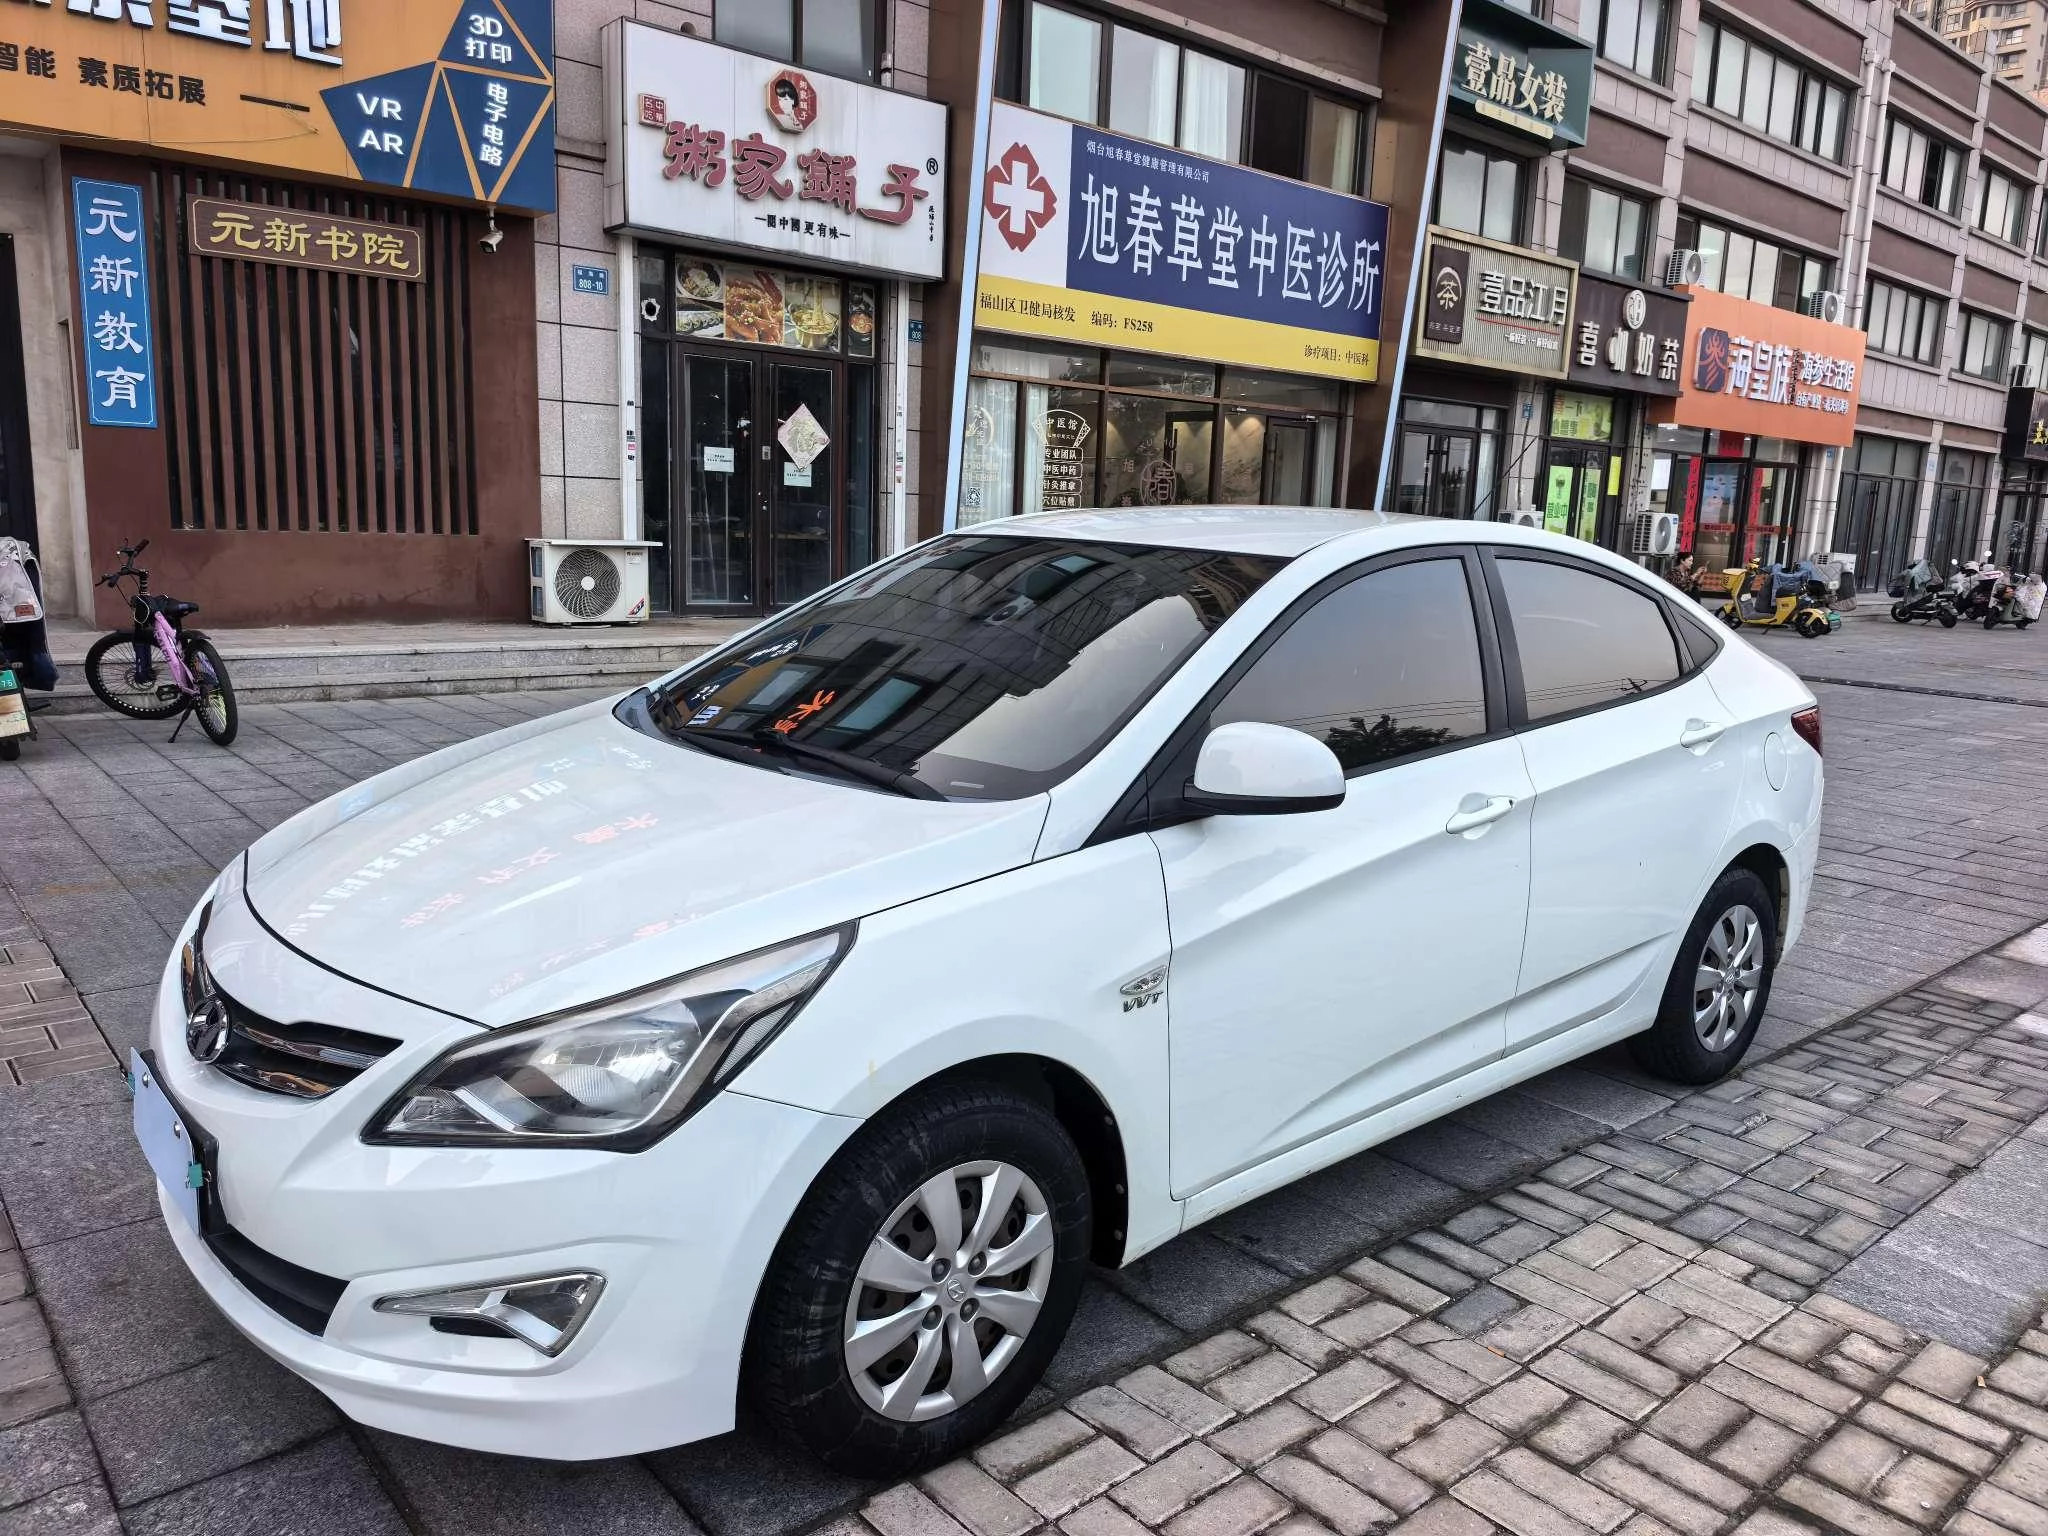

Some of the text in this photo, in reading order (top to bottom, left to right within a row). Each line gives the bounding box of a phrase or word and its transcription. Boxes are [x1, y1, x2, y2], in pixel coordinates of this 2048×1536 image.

[469, 14, 503, 38] 3D
[466, 37, 512, 64] 打印
[78, 56, 206, 106] 素质拓展
[1460, 41, 1568, 124] 壹品女装
[356, 93, 403, 121] VR
[479, 82, 509, 167] 电子电路
[358, 128, 404, 155] AR
[1086, 140, 1210, 183] 烟台旭春草堂健康管理有限公司
[208, 211, 411, 271] 元新书院
[1078, 173, 1380, 314] 旭春草堂中医诊所
[85, 197, 145, 410] 元新教育
[979, 292, 1076, 323] 福山区卫健局核发
[1476, 270, 1569, 326] 壹品江月
[1045, 417, 1078, 431] 中医馆
[1043, 464, 1077, 476] 中医中药
[1044, 448, 1077, 460] 专业团队
